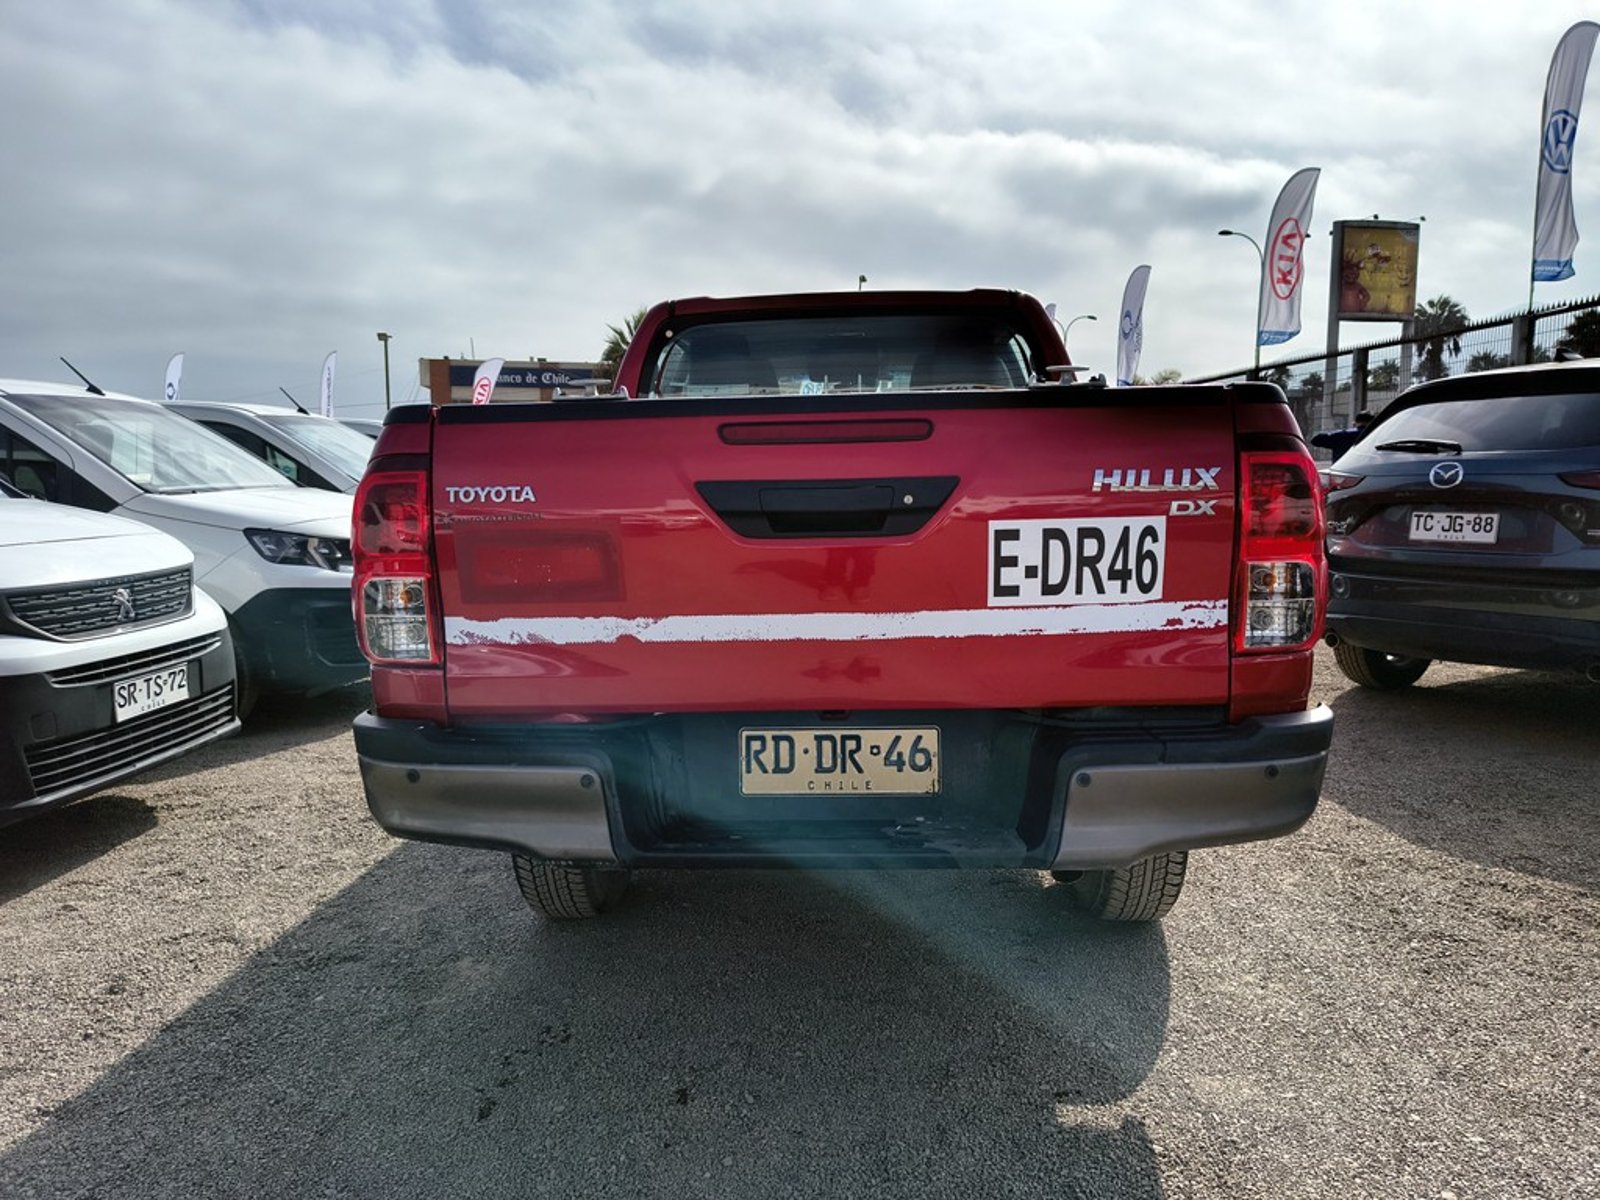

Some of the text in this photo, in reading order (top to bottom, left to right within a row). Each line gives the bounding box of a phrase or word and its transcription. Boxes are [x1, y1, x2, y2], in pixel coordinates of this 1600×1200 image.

[1276, 232, 1298, 286] KIA
[495, 374, 523, 384] anco
[525, 372, 538, 384] de
[1092, 466, 1221, 492] HILUX
[445, 485, 536, 503] TOYOTA
[1169, 499, 1218, 516] DX
[993, 524, 1159, 597] E-DR46
[807, 780, 873, 790] CHILE
